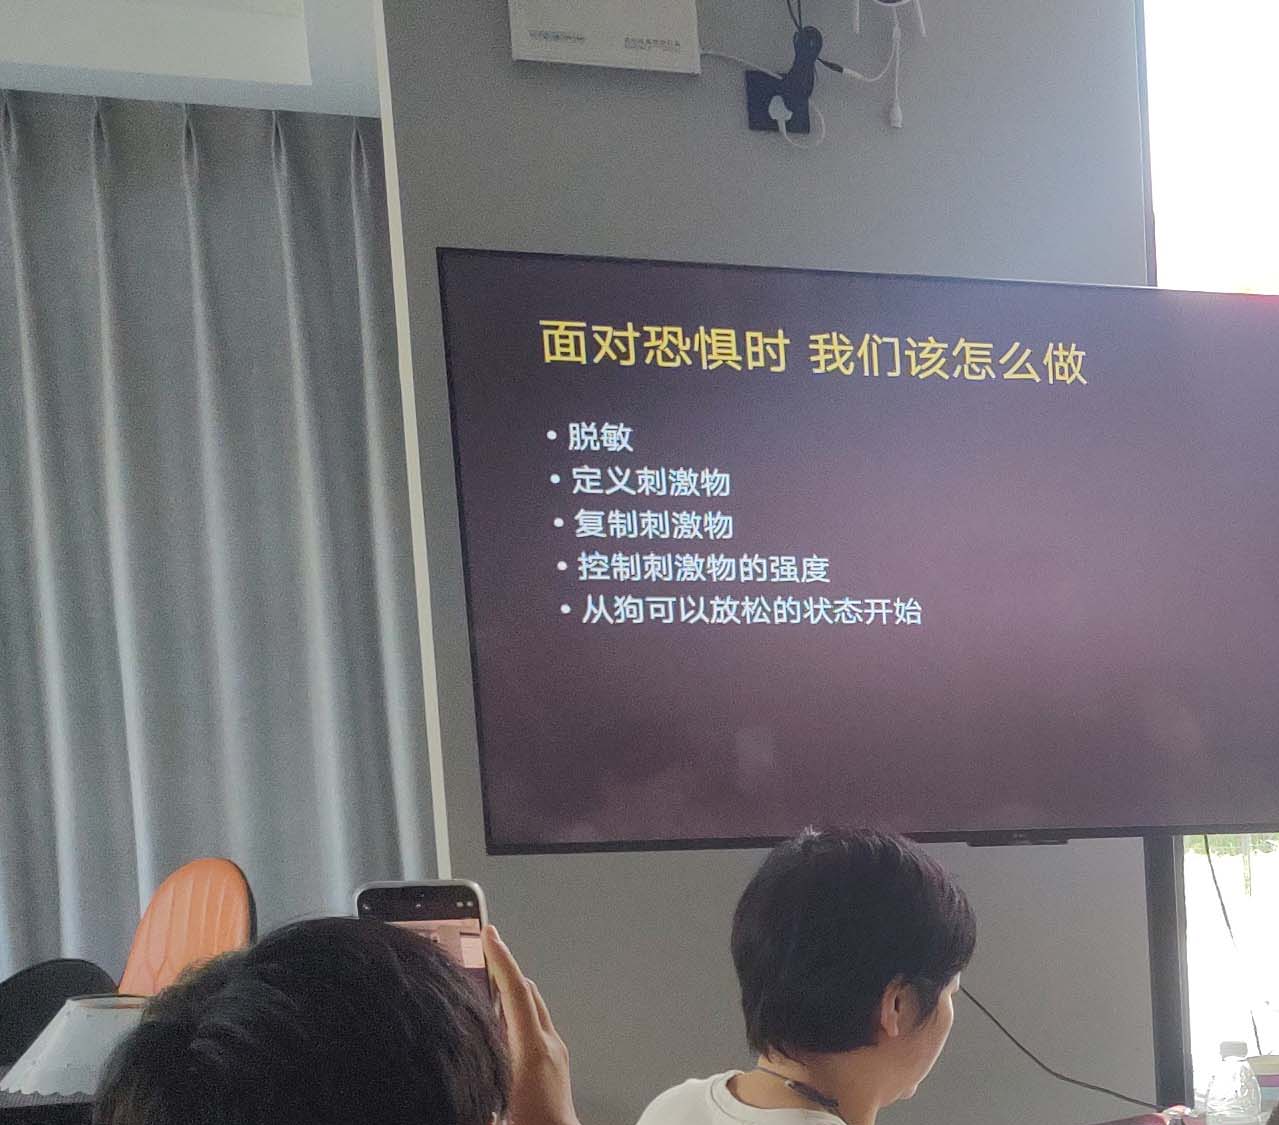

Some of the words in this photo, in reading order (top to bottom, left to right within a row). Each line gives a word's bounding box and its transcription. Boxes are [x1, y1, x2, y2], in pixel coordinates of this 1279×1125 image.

[539, 320, 790, 373] 面对恐惧时
[808, 331, 1088, 385] 我们该怎么做
[568, 422, 634, 452] 脱敏
[572, 465, 731, 497] 定义刺激物
[574, 509, 733, 540] 复制刺激物
[577, 551, 832, 583] 控制刺激物的强度
[582, 595, 923, 625] 从狗可以放松的状态开始
